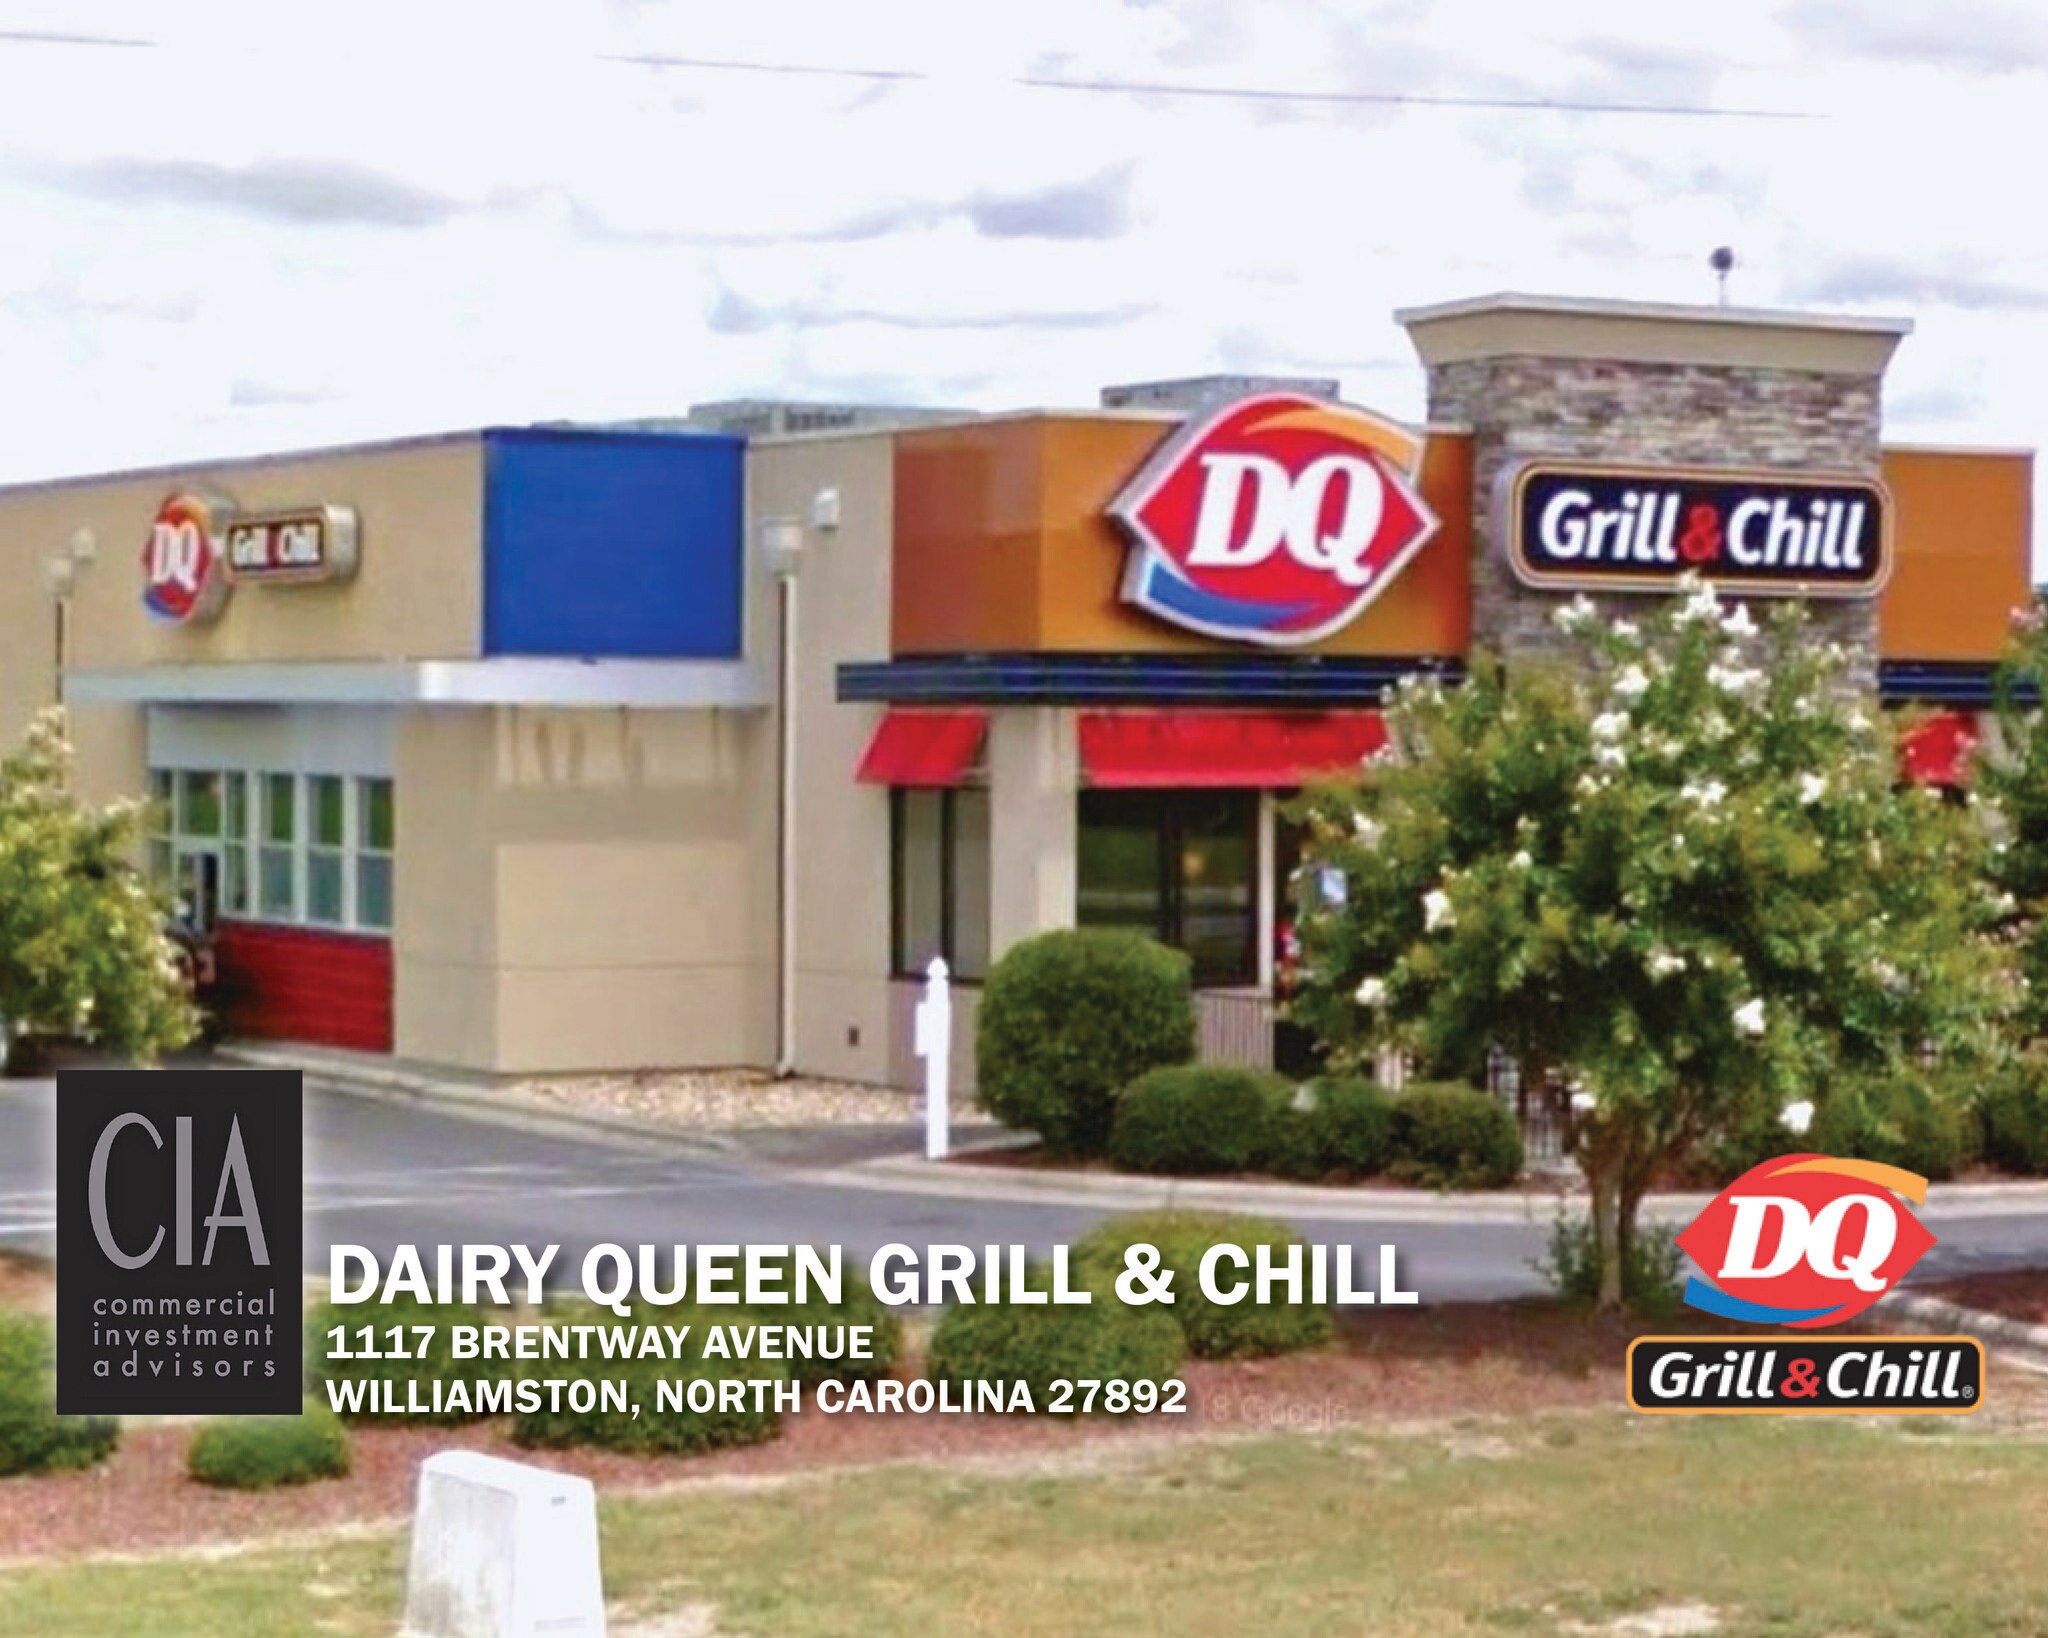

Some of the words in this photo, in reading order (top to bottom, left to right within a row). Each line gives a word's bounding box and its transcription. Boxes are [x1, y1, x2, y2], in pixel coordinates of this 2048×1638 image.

[151, 521, 200, 593] DQ
[1184, 452, 1384, 587] DQ
[1539, 489, 1682, 562] Grill
[1726, 497, 1866, 569] Chill
